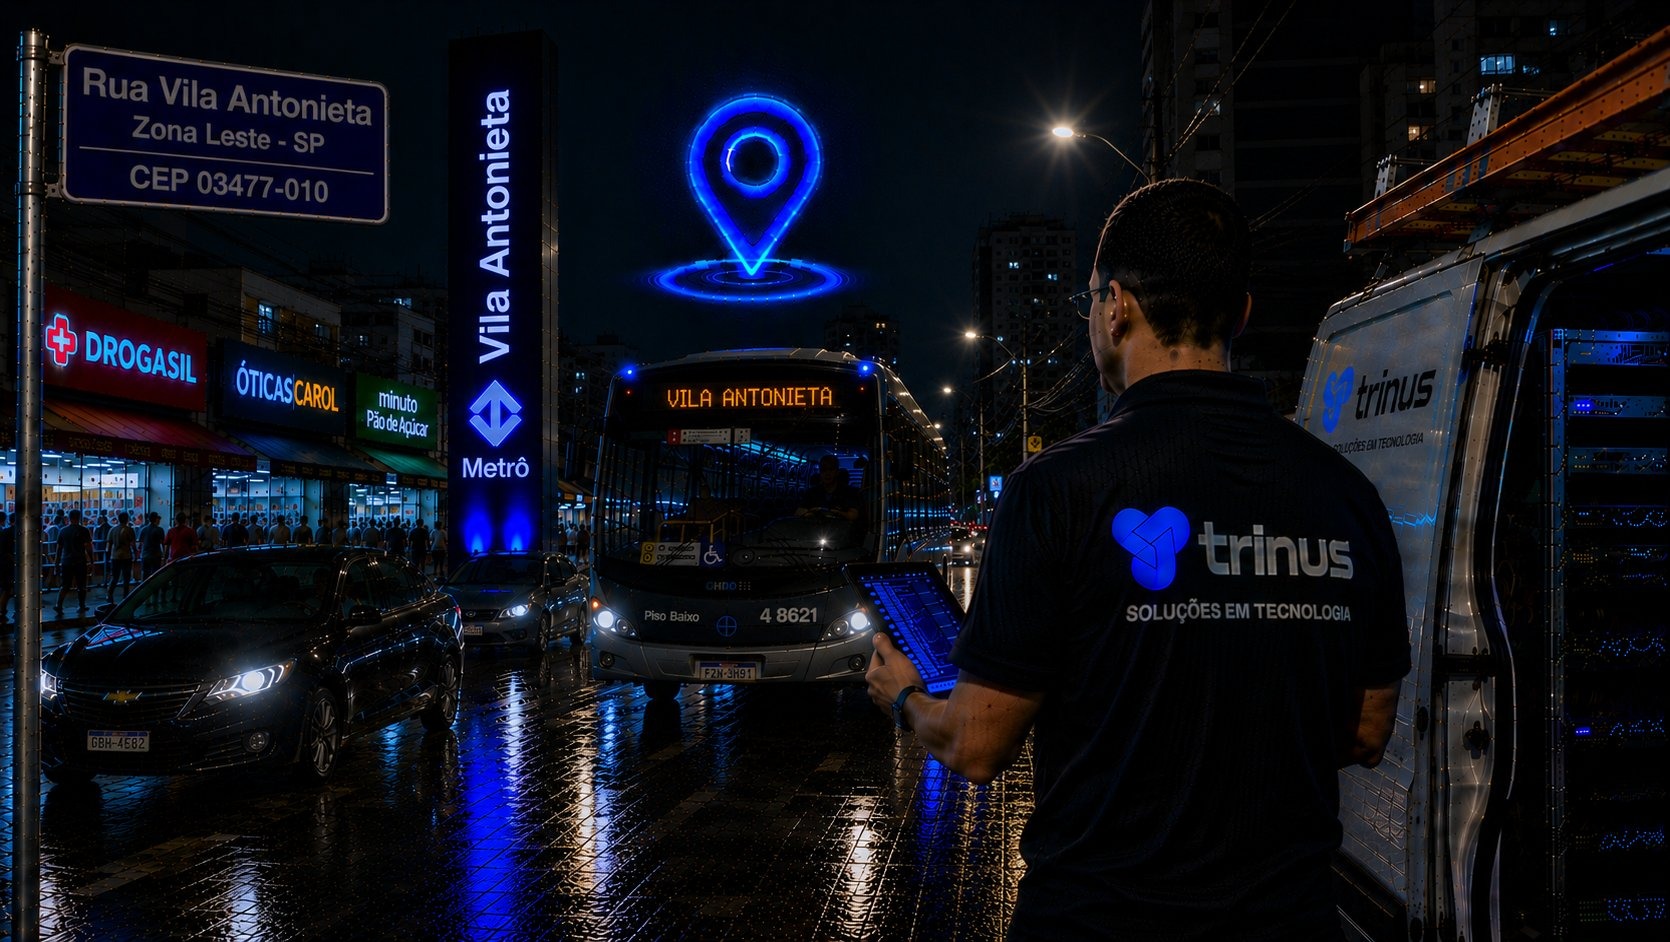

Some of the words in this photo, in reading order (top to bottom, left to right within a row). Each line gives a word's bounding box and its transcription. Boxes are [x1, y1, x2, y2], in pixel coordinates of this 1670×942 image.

[83, 67, 148, 102] Rua
[159, 75, 218, 110] Vila
[227, 85, 372, 126] Antonieta
[132, 115, 197, 143] Zona
[206, 123, 271, 150] Leste
[294, 132, 325, 153] SP
[130, 164, 189, 192] CEP
[197, 170, 328, 202] 03477-010
[479, 88, 510, 277] Antonieta
[479, 289, 510, 364] Vila
[85, 331, 197, 384] DROGASIL
[236, 360, 293, 404] ÓTICAS
[294, 379, 339, 413] CAROL
[378, 390, 418, 413] minuto
[667, 388, 712, 408] VILA
[722, 387, 833, 407] ANTONIETA
[1355, 369, 1437, 420] trinus
[366, 409, 385, 430] Pão
[386, 414, 398, 432] de
[399, 416, 429, 439] Açúcar
[1378, 432, 1424, 449] TECNOLOGIA
[462, 456, 530, 479] Metrô
[1198, 521, 1354, 580] trinus
[644, 610, 666, 622] Piso
[669, 610, 700, 623] Baixo
[759, 608, 772, 623] 4
[776, 607, 818, 623] 8621
[1126, 598, 1221, 624] SOLUÇÕES
[1225, 602, 1250, 620] EM
[1254, 602, 1352, 622] TECNOLOGIA
